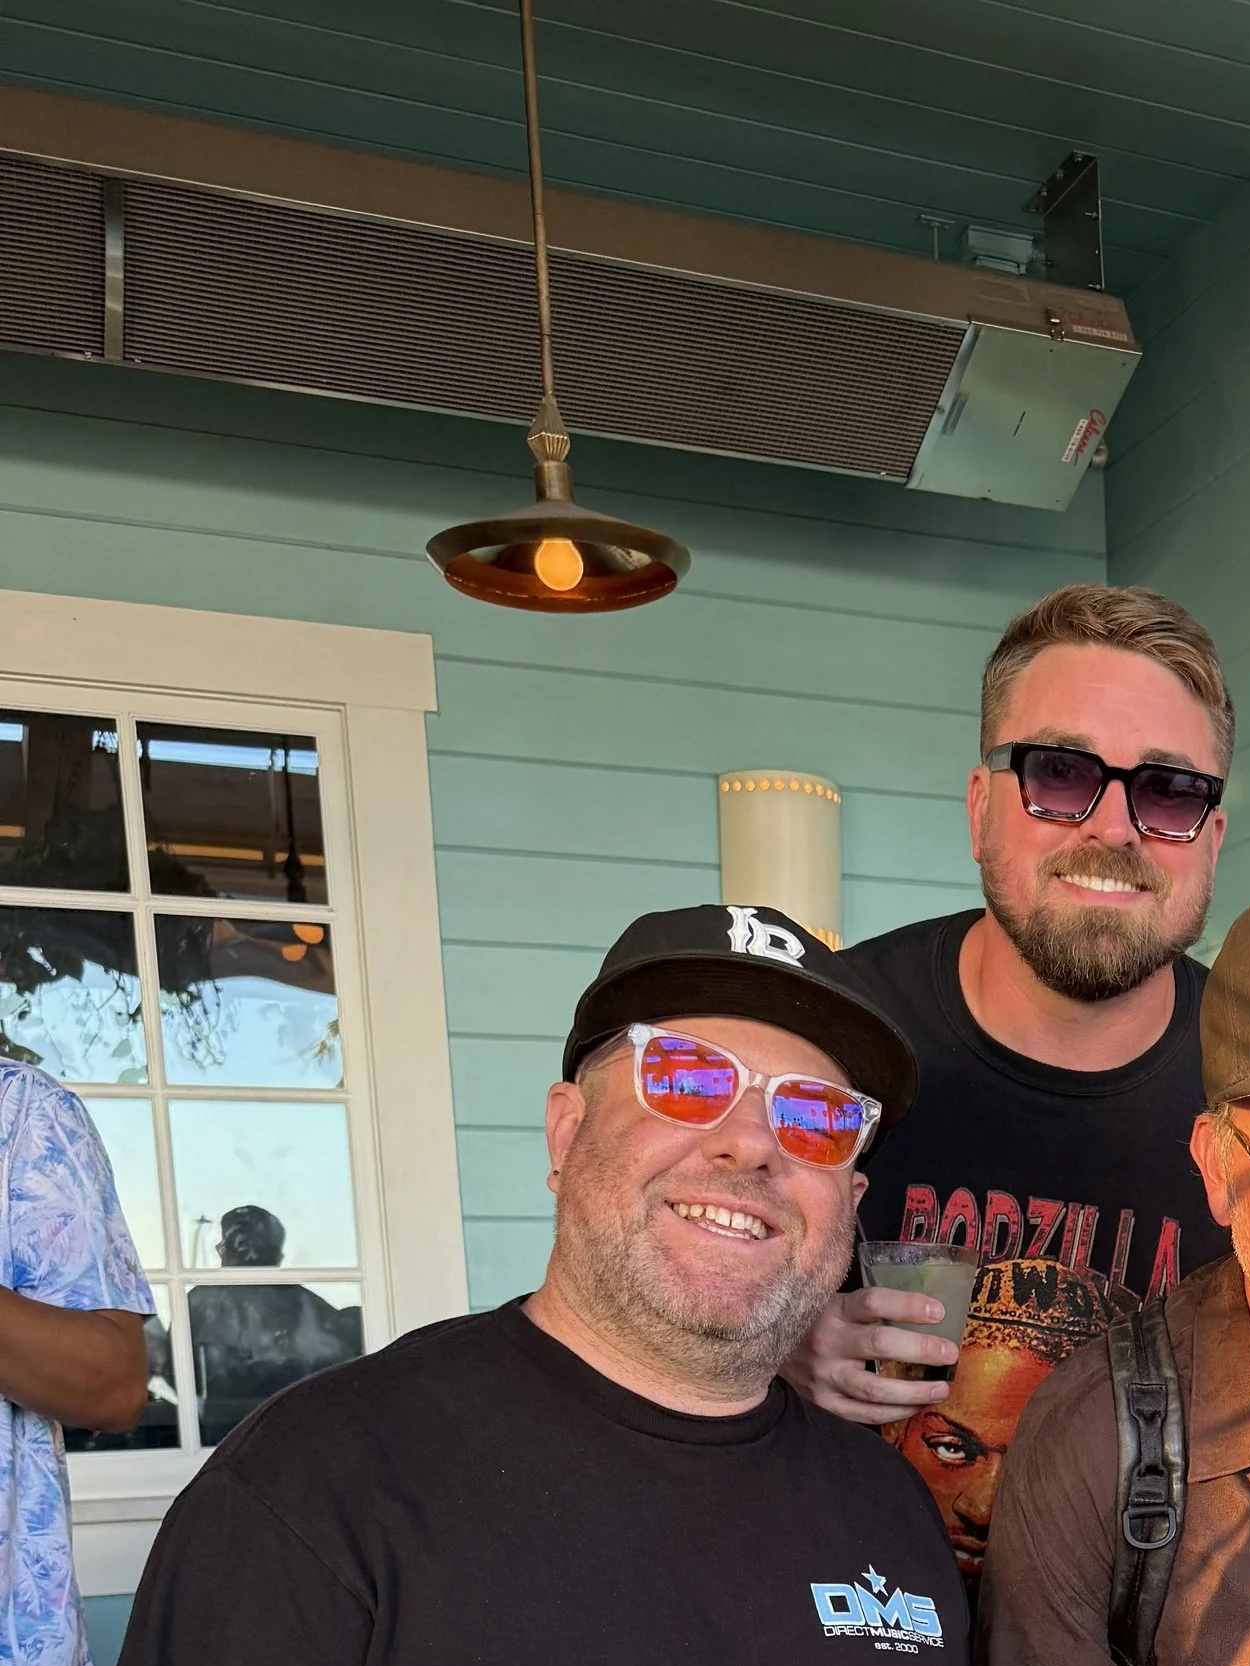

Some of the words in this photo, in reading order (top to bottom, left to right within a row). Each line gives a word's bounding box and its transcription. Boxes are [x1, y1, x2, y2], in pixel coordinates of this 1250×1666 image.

[810, 1581, 943, 1638] DMS
[874, 1642, 894, 1651] est.
[895, 1642, 919, 1654] 2000
